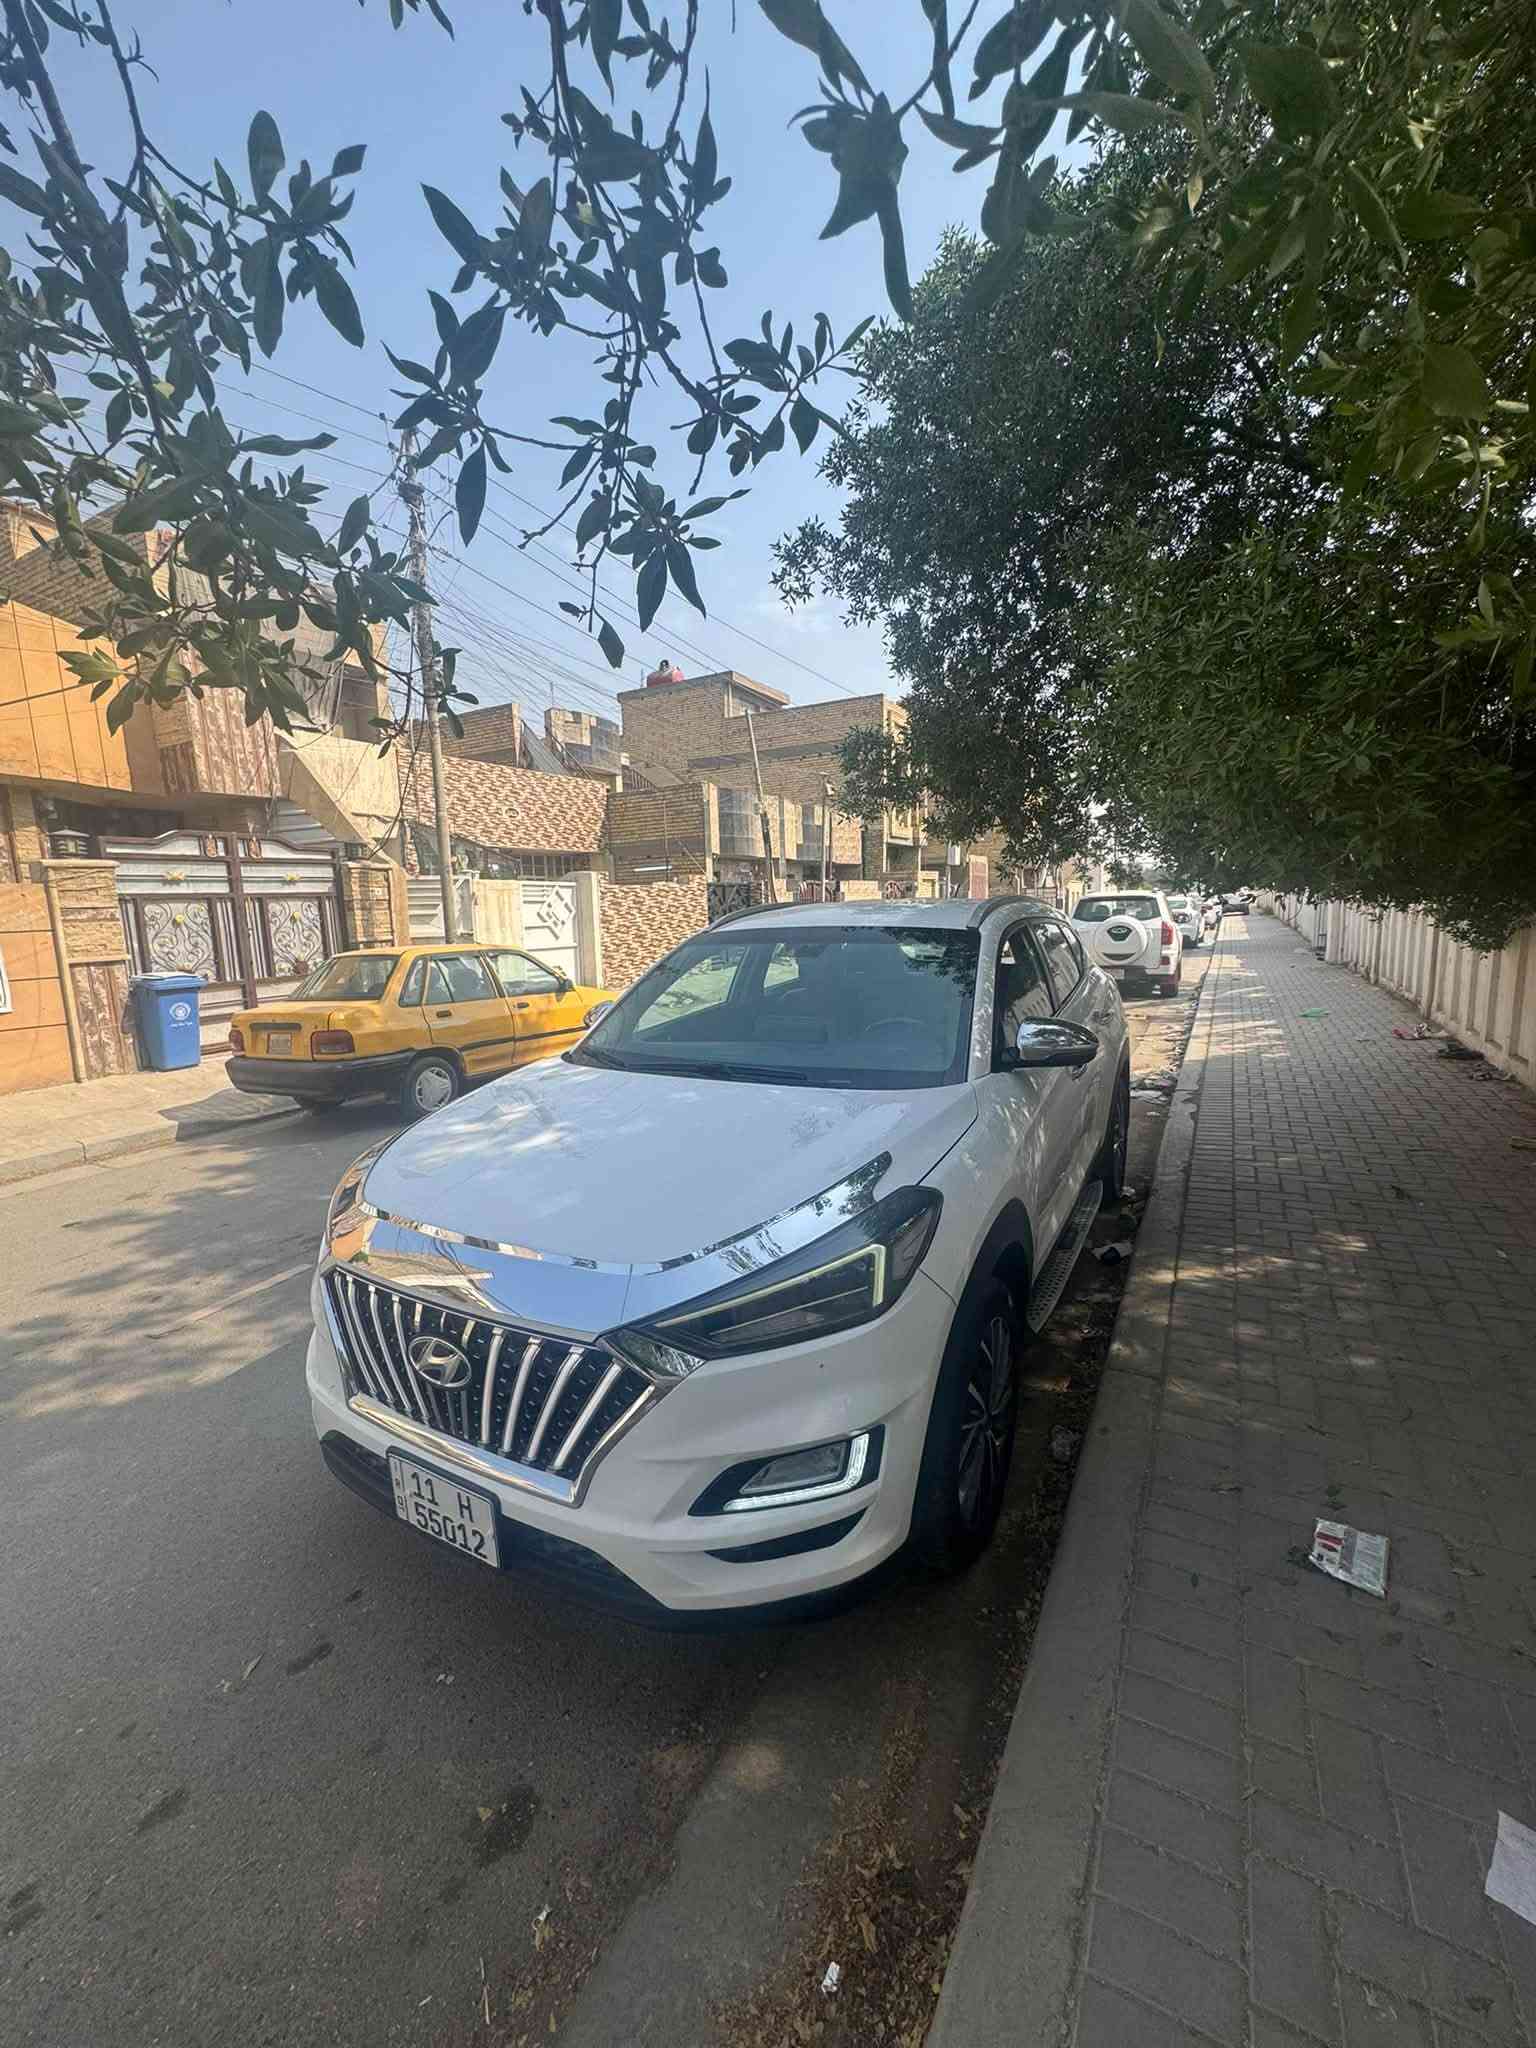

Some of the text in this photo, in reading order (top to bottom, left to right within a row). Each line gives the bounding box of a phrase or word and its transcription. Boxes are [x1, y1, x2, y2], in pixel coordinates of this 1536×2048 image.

[411, 1472, 474, 1523] 11 H
[414, 1502, 488, 1559] 55012
